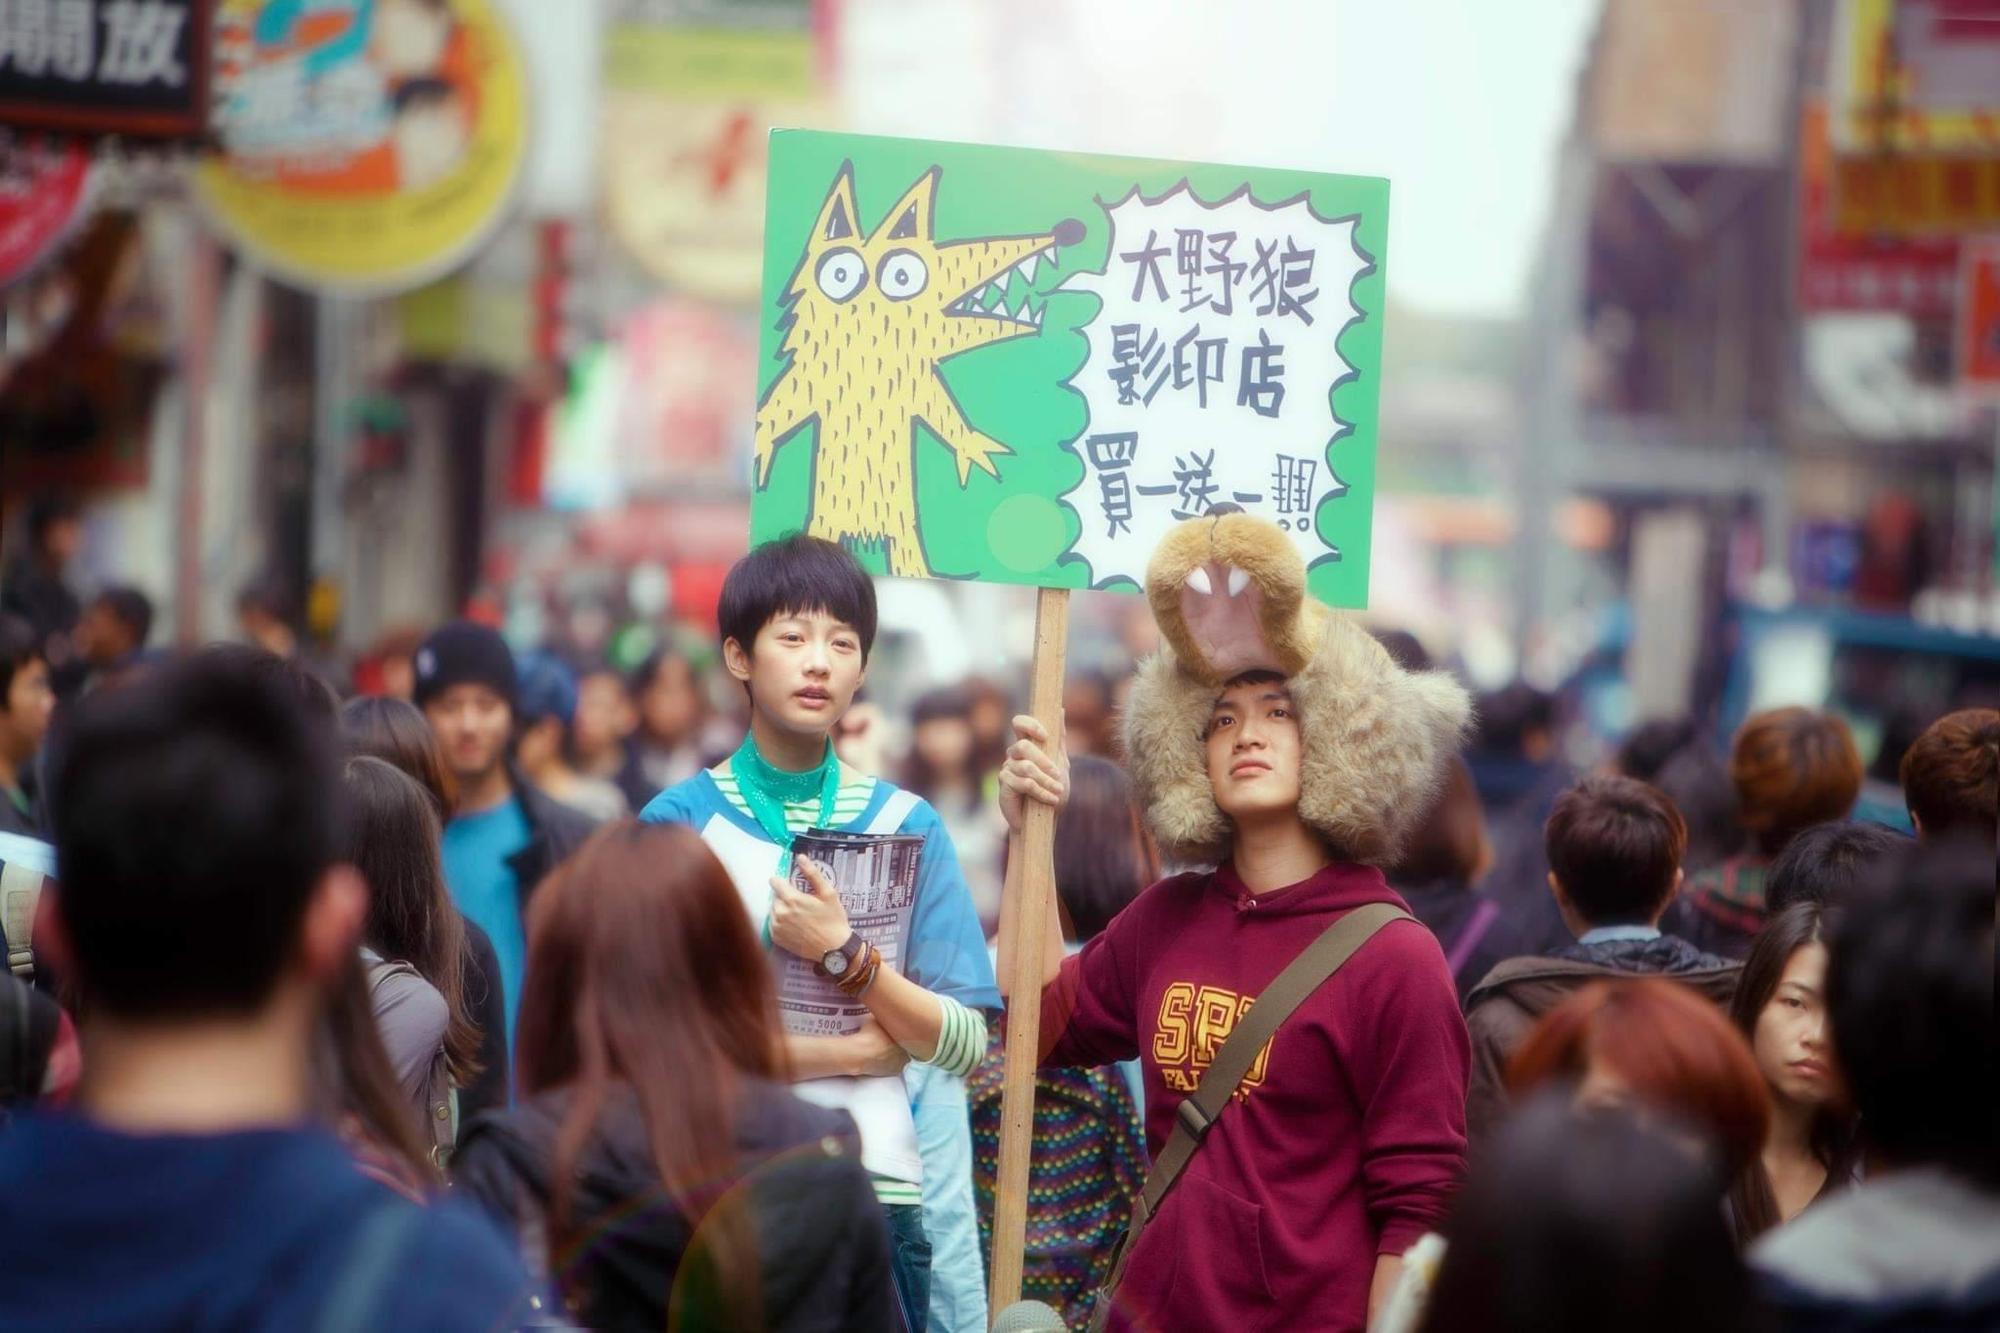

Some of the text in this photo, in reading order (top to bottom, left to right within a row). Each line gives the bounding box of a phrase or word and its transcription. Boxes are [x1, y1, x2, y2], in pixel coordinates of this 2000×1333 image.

[1119, 228, 1319, 326] 大野狼
[1108, 323, 1286, 418] 影印店
[817, 1019, 842, 1031] 5000
